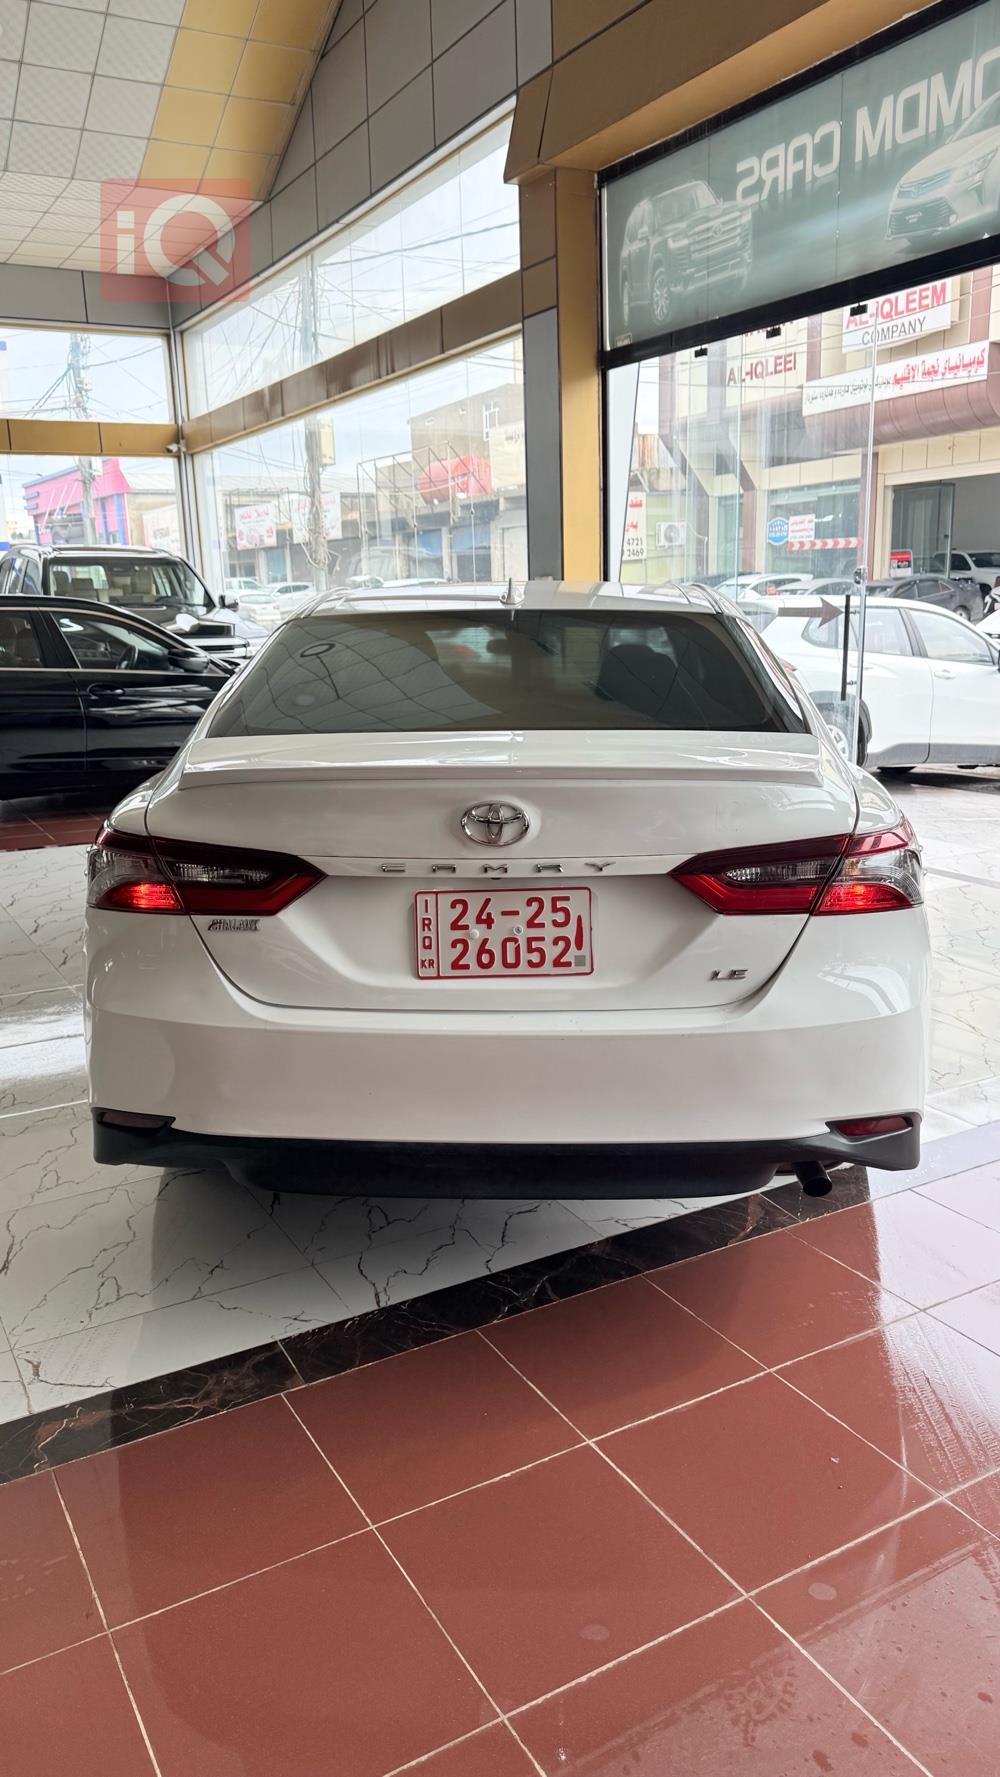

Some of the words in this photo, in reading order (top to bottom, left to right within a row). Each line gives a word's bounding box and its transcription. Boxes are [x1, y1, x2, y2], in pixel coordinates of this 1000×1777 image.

[862, 316, 926, 345] COMPANY
[381, 862, 617, 873] CAMRY
[450, 896, 572, 931] 24-25
[450, 935, 573, 970] 26052
[420, 959, 435, 969] KR
[709, 968, 749, 981] LE
